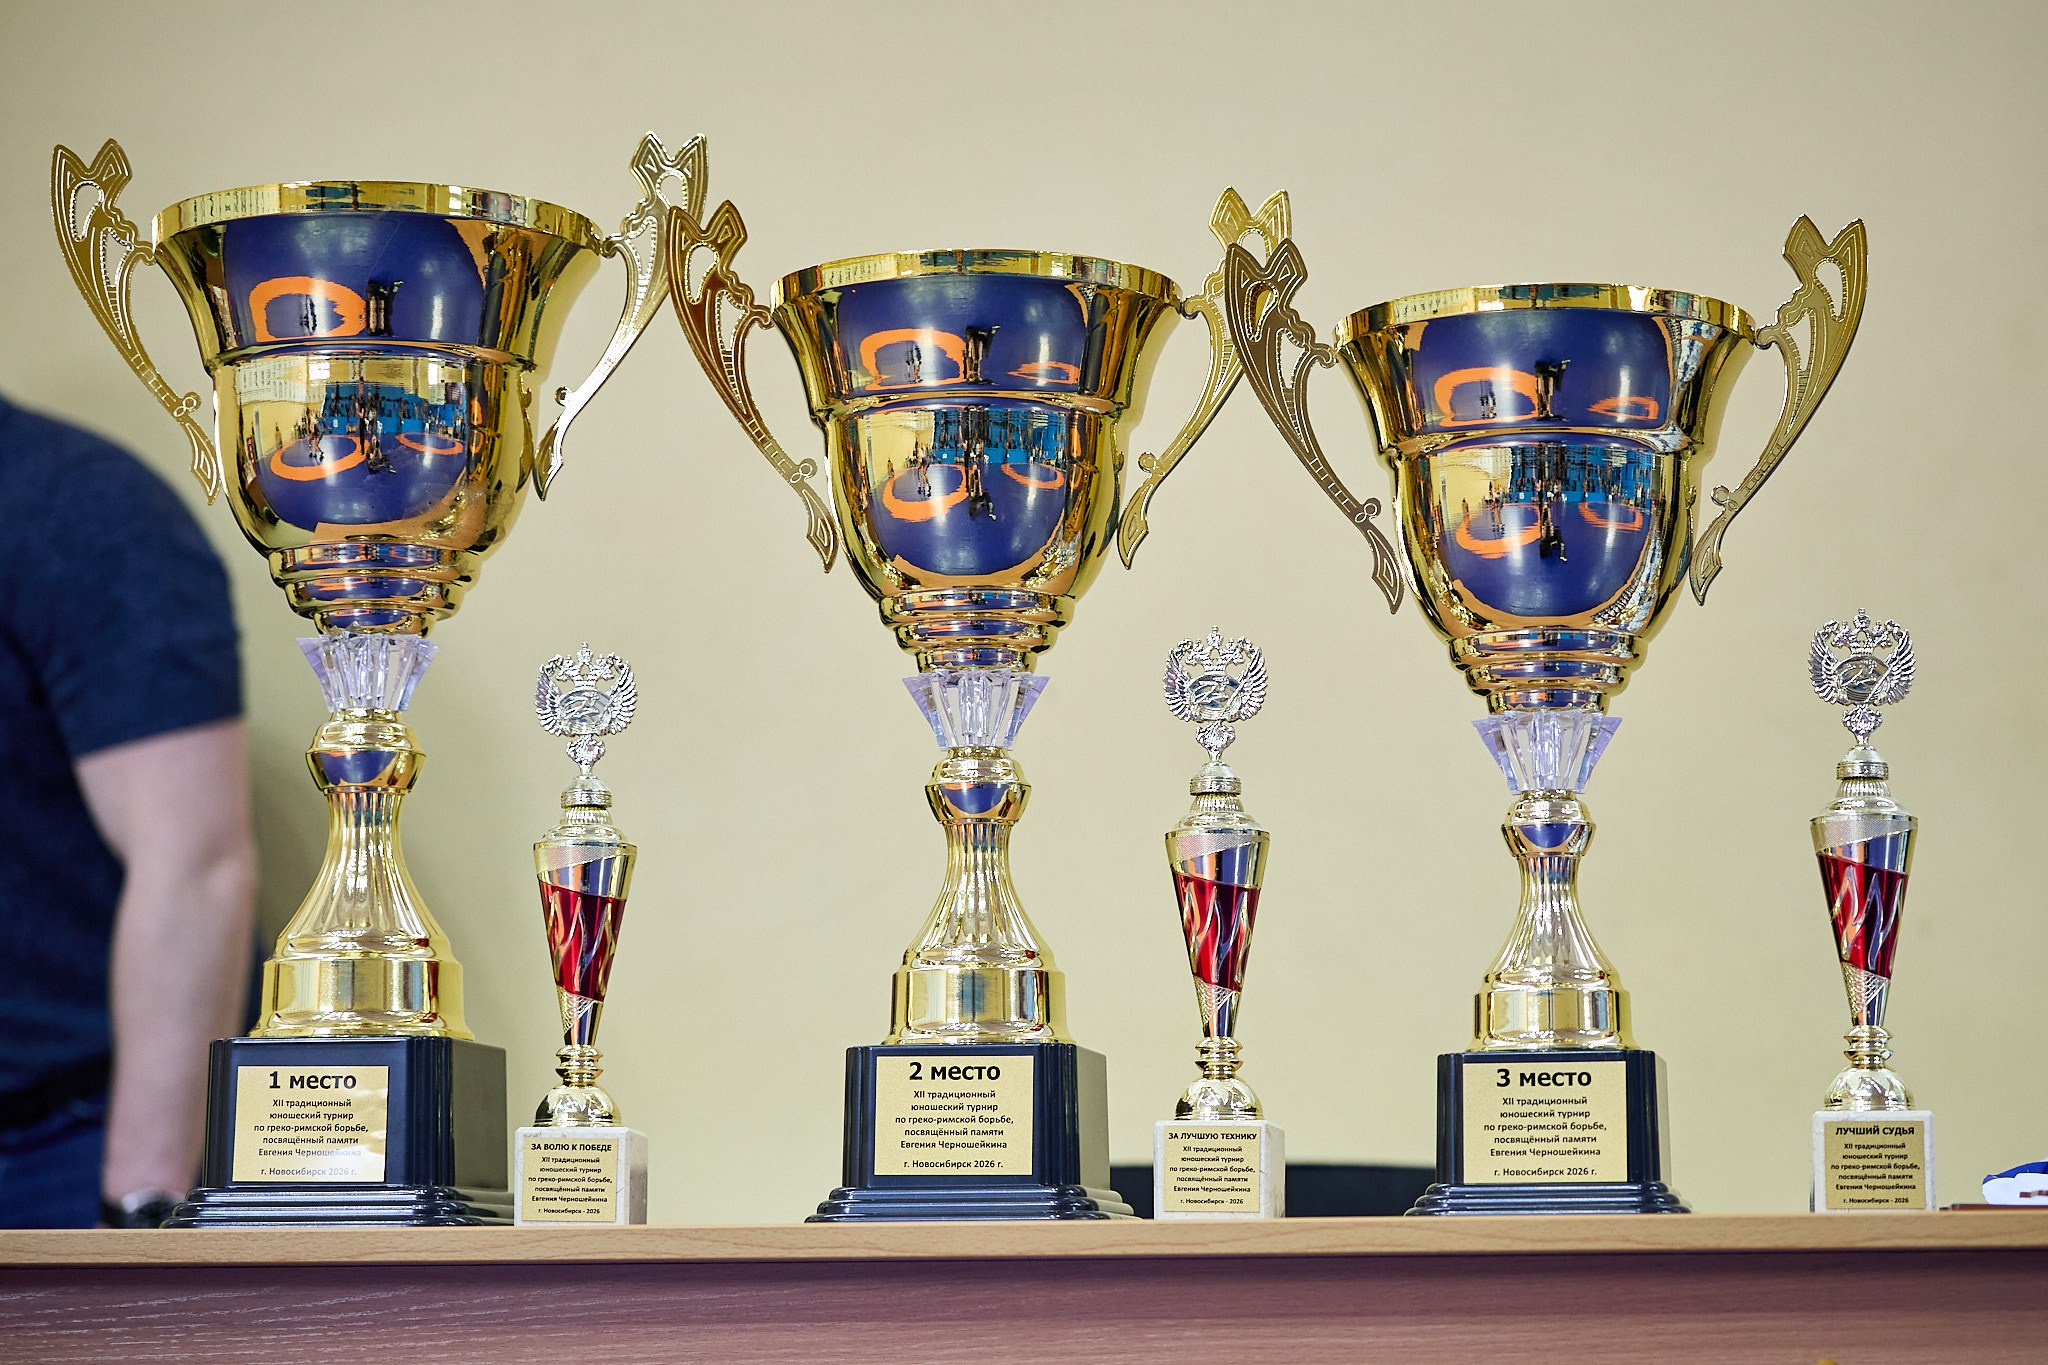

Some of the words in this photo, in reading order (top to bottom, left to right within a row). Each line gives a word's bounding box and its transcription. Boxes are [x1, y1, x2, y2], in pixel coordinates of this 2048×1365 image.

[909, 1062, 922, 1080] 2
[931, 1065, 1000, 1080] место
[269, 1071, 281, 1089] 1
[289, 1075, 357, 1089] место
[1496, 1068, 1510, 1087] 3
[1519, 1071, 1592, 1087] место
[914, 1090, 925, 1098] XII
[927, 1090, 996, 1099] традиционный
[286, 1099, 351, 1108] традиционный
[1517, 1096, 1587, 1107] традиционный
[911, 1103, 964, 1111] юношеский
[967, 1104, 998, 1113] турнир
[323, 1113, 354, 1121] турнир
[1500, 1110, 1555, 1118] юношеский
[1558, 1111, 1591, 1119] турнир
[908, 1115, 976, 1125] греко-римской
[978, 1115, 1014, 1125] борьбе,
[267, 1124, 332, 1133] греко-римской
[334, 1124, 368, 1133] борьбе,
[1498, 1122, 1568, 1132] греко-римской
[1570, 1122, 1607, 1132] борьбе,
[1835, 1125, 1880, 1135] ЛУЧШИЙ
[1882, 1127, 1915, 1136] СУДЬЯ
[904, 1128, 968, 1137] посвящённый
[263, 1136, 324, 1145] посвящённый
[1494, 1135, 1560, 1145] посвящённый
[579, 1144, 612, 1152] ПОБЕДЕ
[939, 1140, 1007, 1150] Черношейкина
[1854, 1142, 1906, 1150] традиционный
[259, 1148, 293, 1156] Евгения
[295, 1148, 362, 1158] Черношейкина
[1530, 1148, 1601, 1158] Черношейкина
[552, 1156, 600, 1164] традиционный
[912, 1160, 972, 1169] Новосибирск
[974, 1160, 995, 1168] 2026
[1230, 1165, 1256, 1173] борьбе,
[1841, 1163, 1892, 1171] греко-римской
[1893, 1163, 1920, 1171] борьбе,
[270, 1168, 326, 1177] Новосибирск
[1503, 1168, 1564, 1178] Новосибирск
[1567, 1168, 1588, 1176] 2026
[538, 1176, 585, 1184] греко-римской
[587, 1176, 612, 1184] борьбе,
[1200, 1186, 1251, 1194] Черношейкина
[1864, 1183, 1916, 1191] Черношейкина
[559, 1196, 608, 1204] Черношейкина
[1849, 1197, 1889, 1205] Новосибирск
